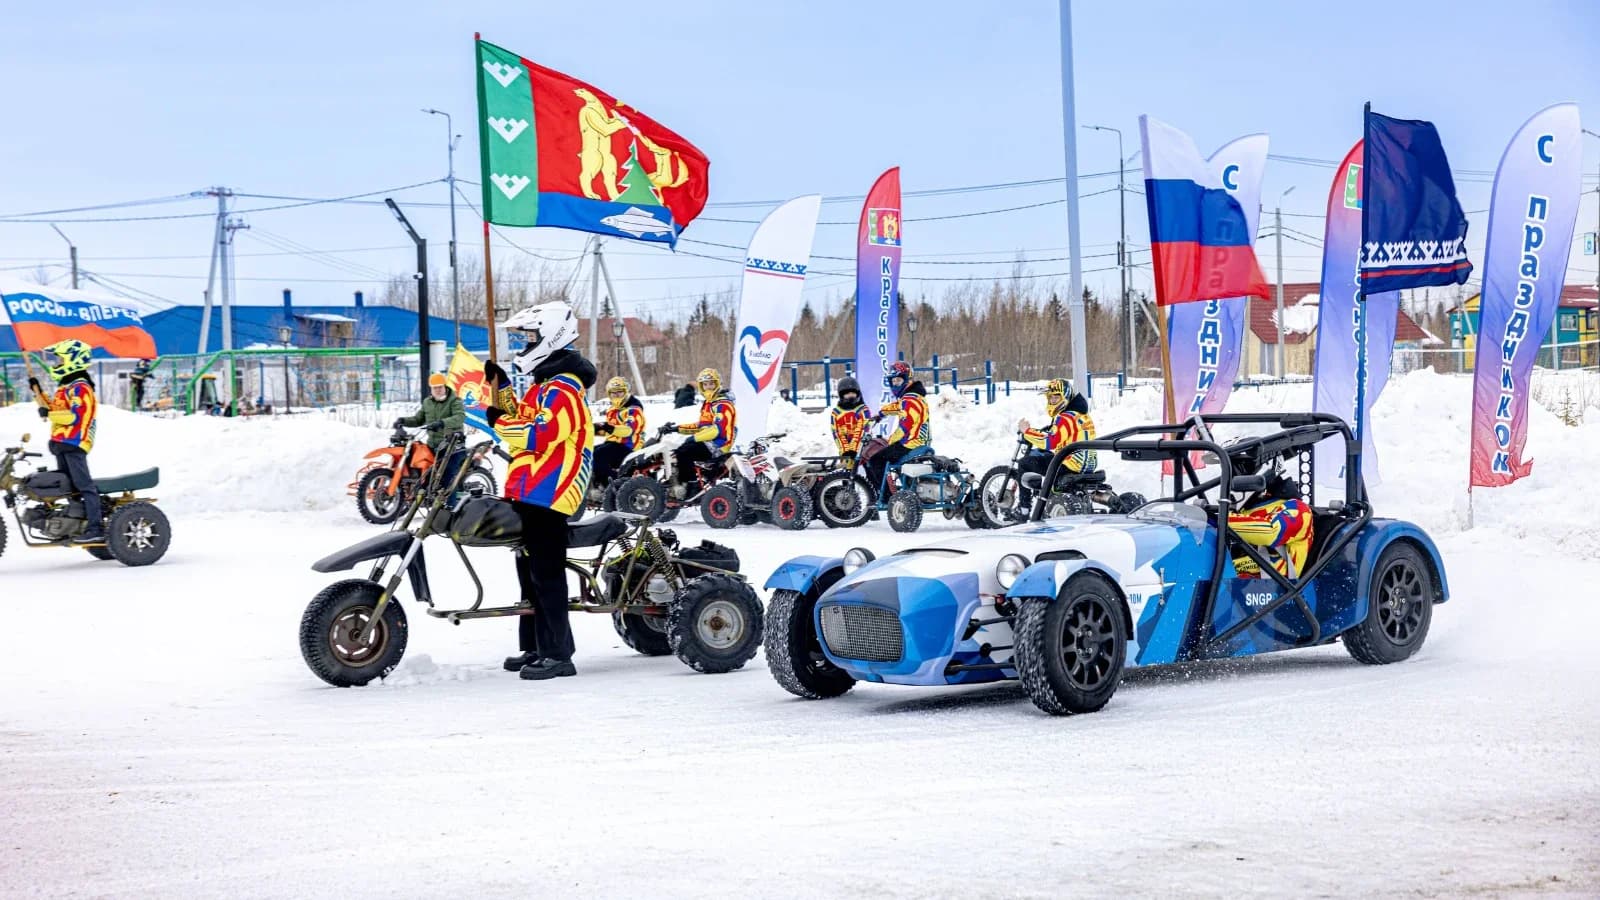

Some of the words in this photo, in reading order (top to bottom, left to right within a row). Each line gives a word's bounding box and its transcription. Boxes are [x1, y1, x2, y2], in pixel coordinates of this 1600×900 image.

[1536, 134, 1554, 164] С
[1222, 164, 1240, 191] С
[7, 298, 77, 317] РОССИ
